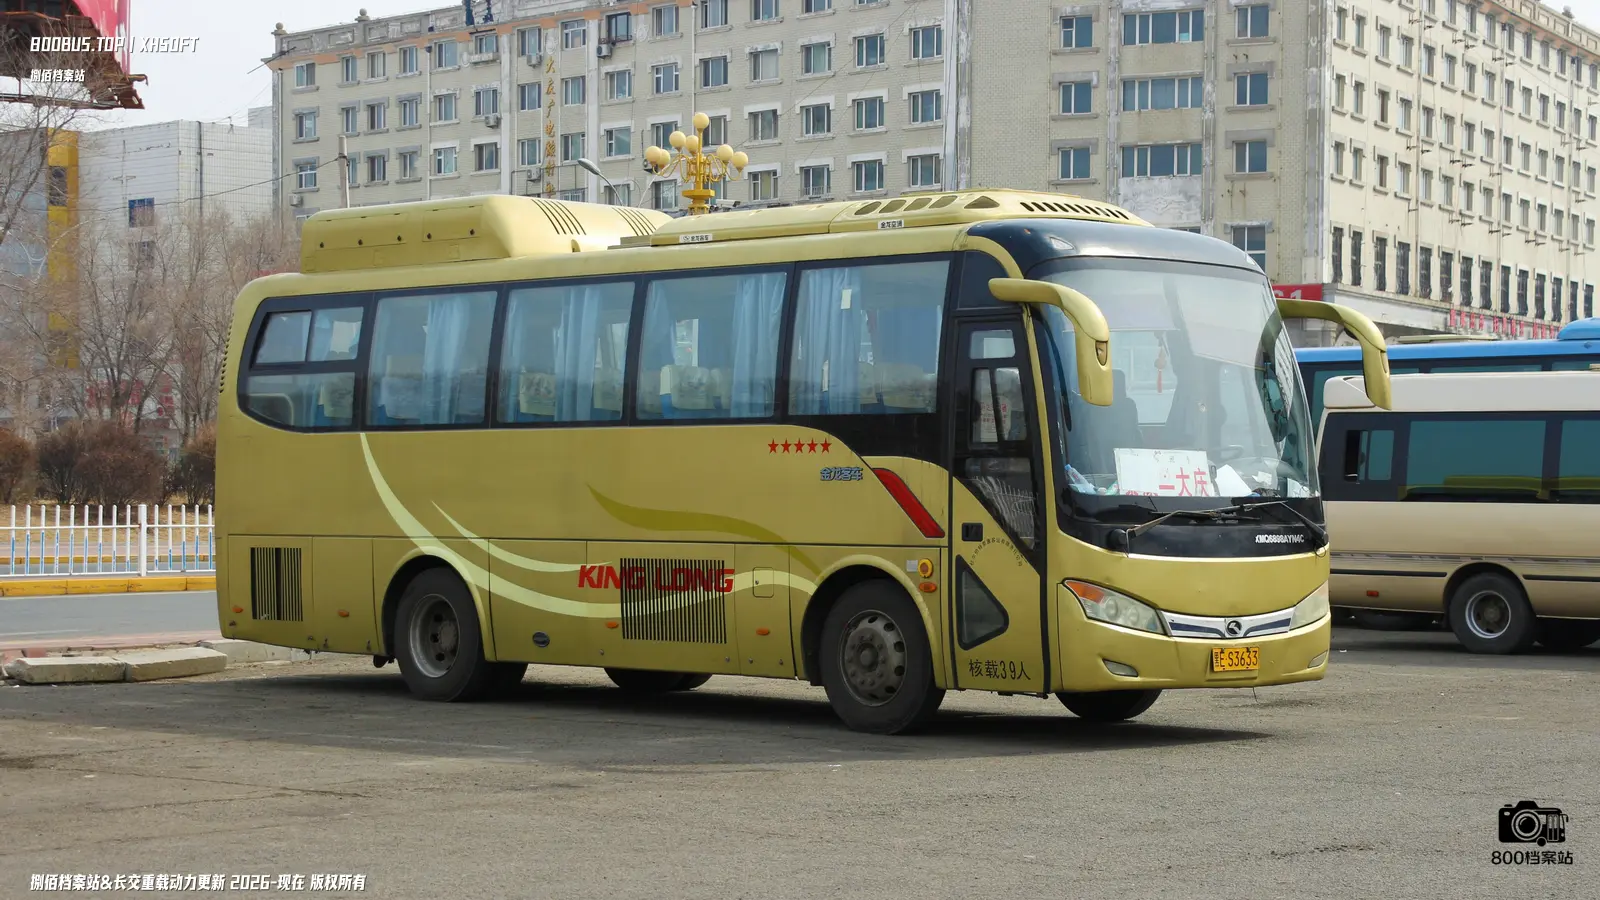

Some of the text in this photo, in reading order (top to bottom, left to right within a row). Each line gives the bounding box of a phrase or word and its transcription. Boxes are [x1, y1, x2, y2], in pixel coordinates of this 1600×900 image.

[820, 466, 863, 481] 金龙客车
[578, 565, 735, 593] KING LONG
[968, 659, 1031, 681] 核载39人
